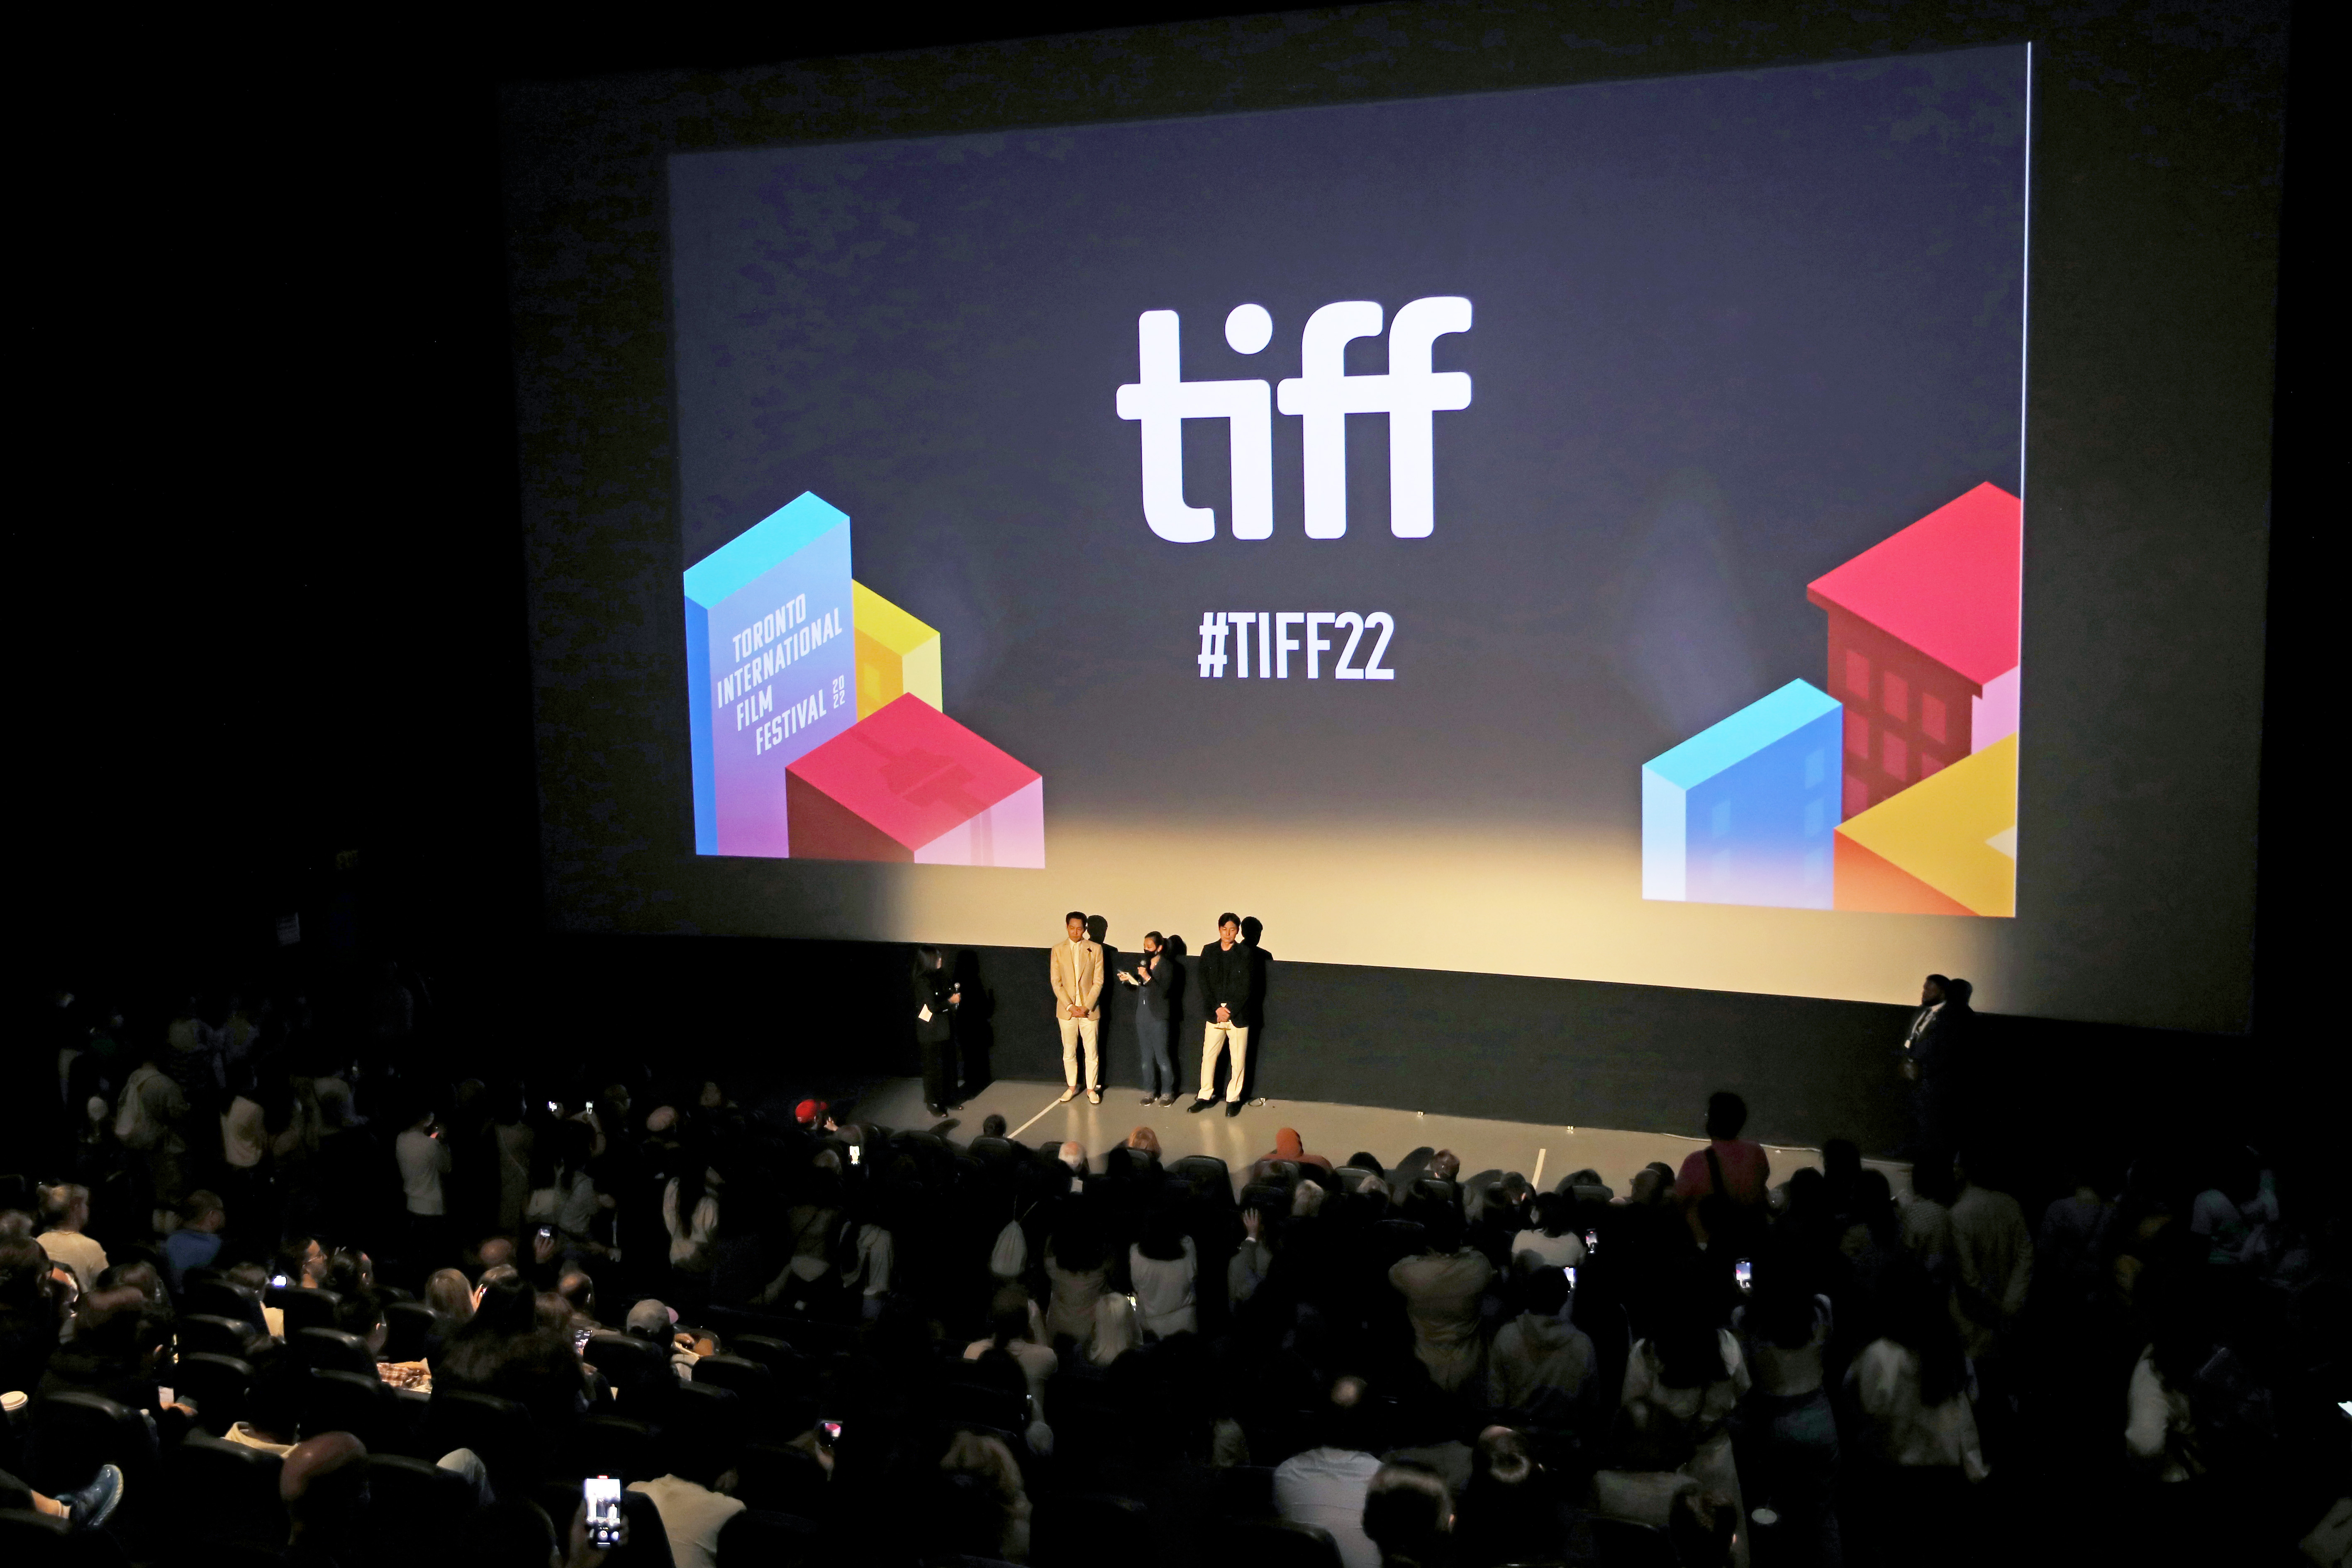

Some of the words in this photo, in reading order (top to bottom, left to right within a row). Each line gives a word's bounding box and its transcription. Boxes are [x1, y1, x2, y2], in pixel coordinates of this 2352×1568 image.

[1116, 296, 1472, 543] tiff
[717, 607, 842, 708] INTERNATIONAL
[733, 593, 806, 663] TORONTO
[1197, 611, 1394, 680] #TIFF22
[737, 685, 773, 732] FILM
[833, 675, 845, 694] 20
[833, 690, 846, 709] 22
[756, 689, 826, 755] FESTIVAL
